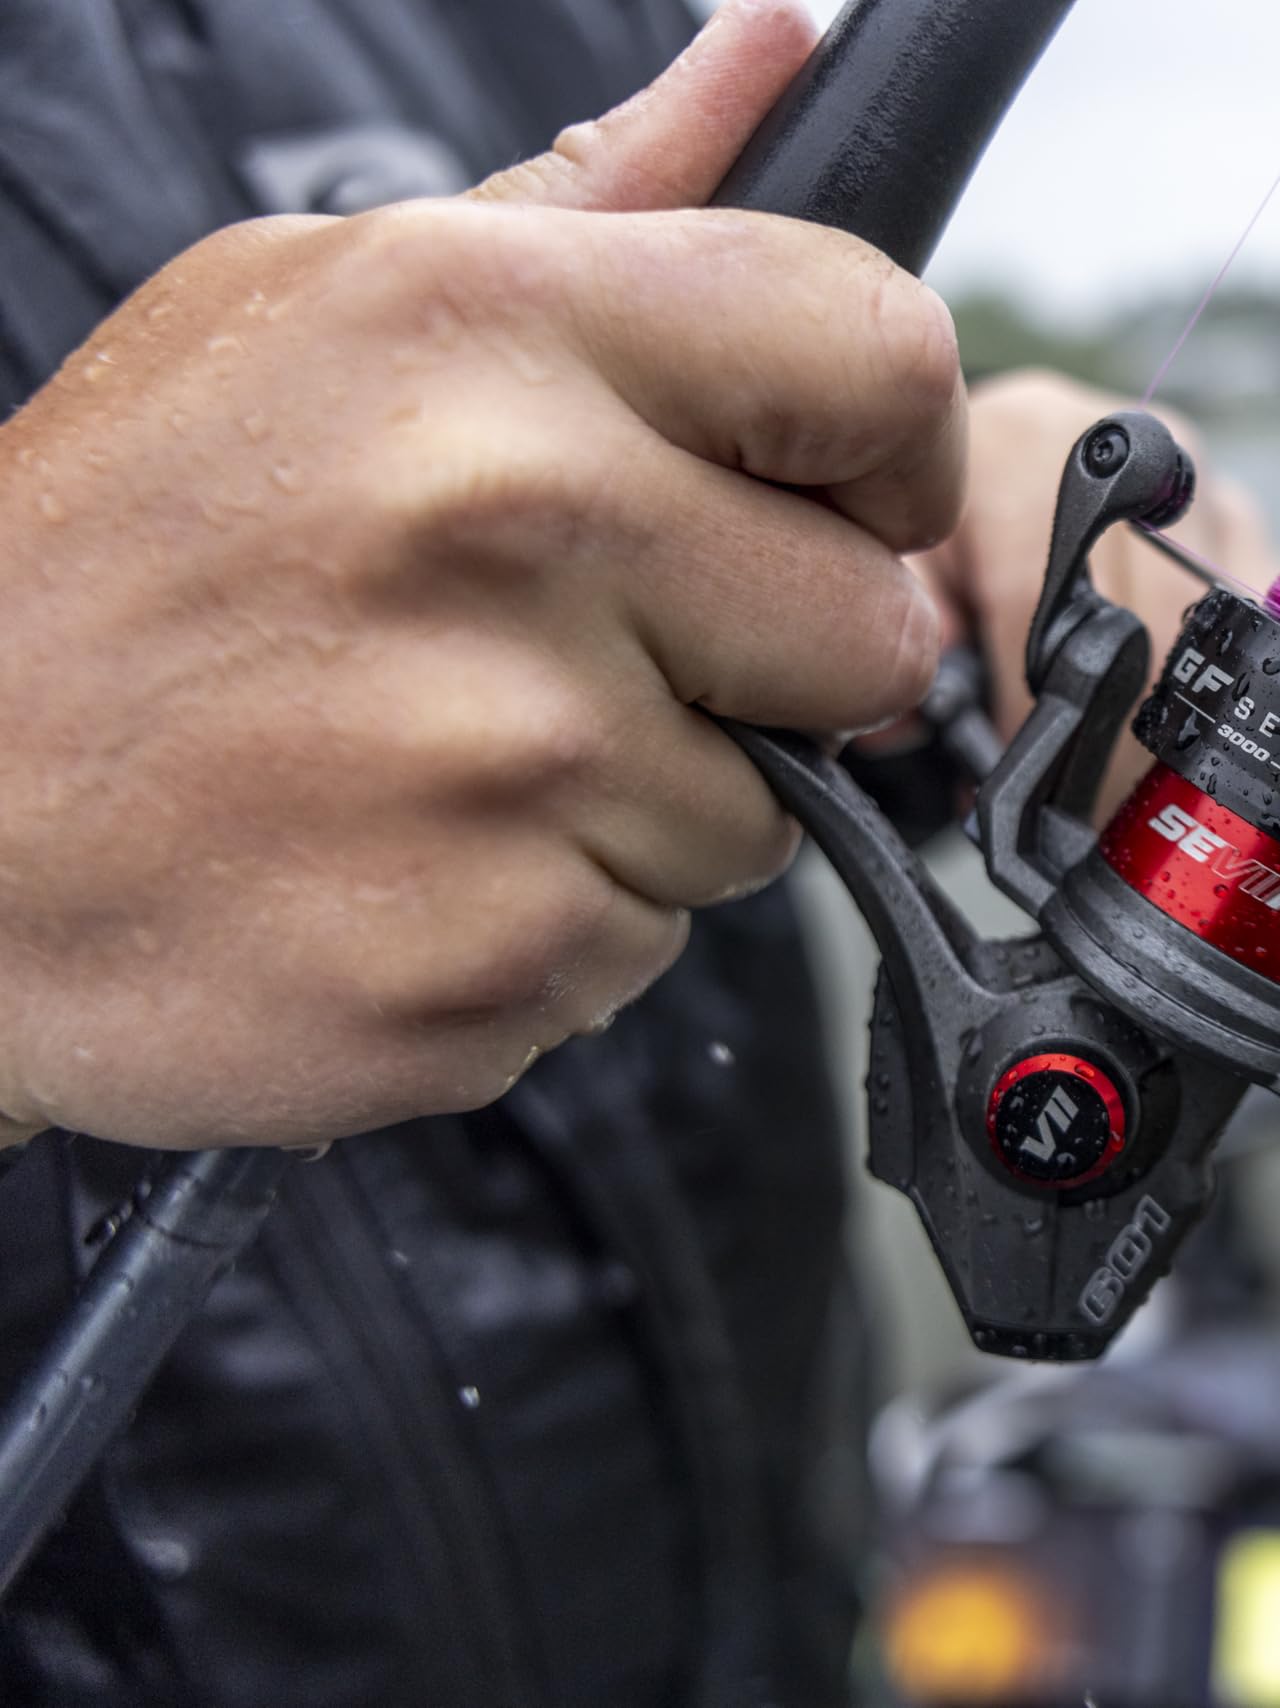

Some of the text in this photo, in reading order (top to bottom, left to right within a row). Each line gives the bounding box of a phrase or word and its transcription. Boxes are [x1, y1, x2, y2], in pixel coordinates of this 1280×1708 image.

[1172, 648, 1234, 693] GF
[1217, 723, 1271, 762] 3000
[1079, 1194, 1171, 1326] 601
